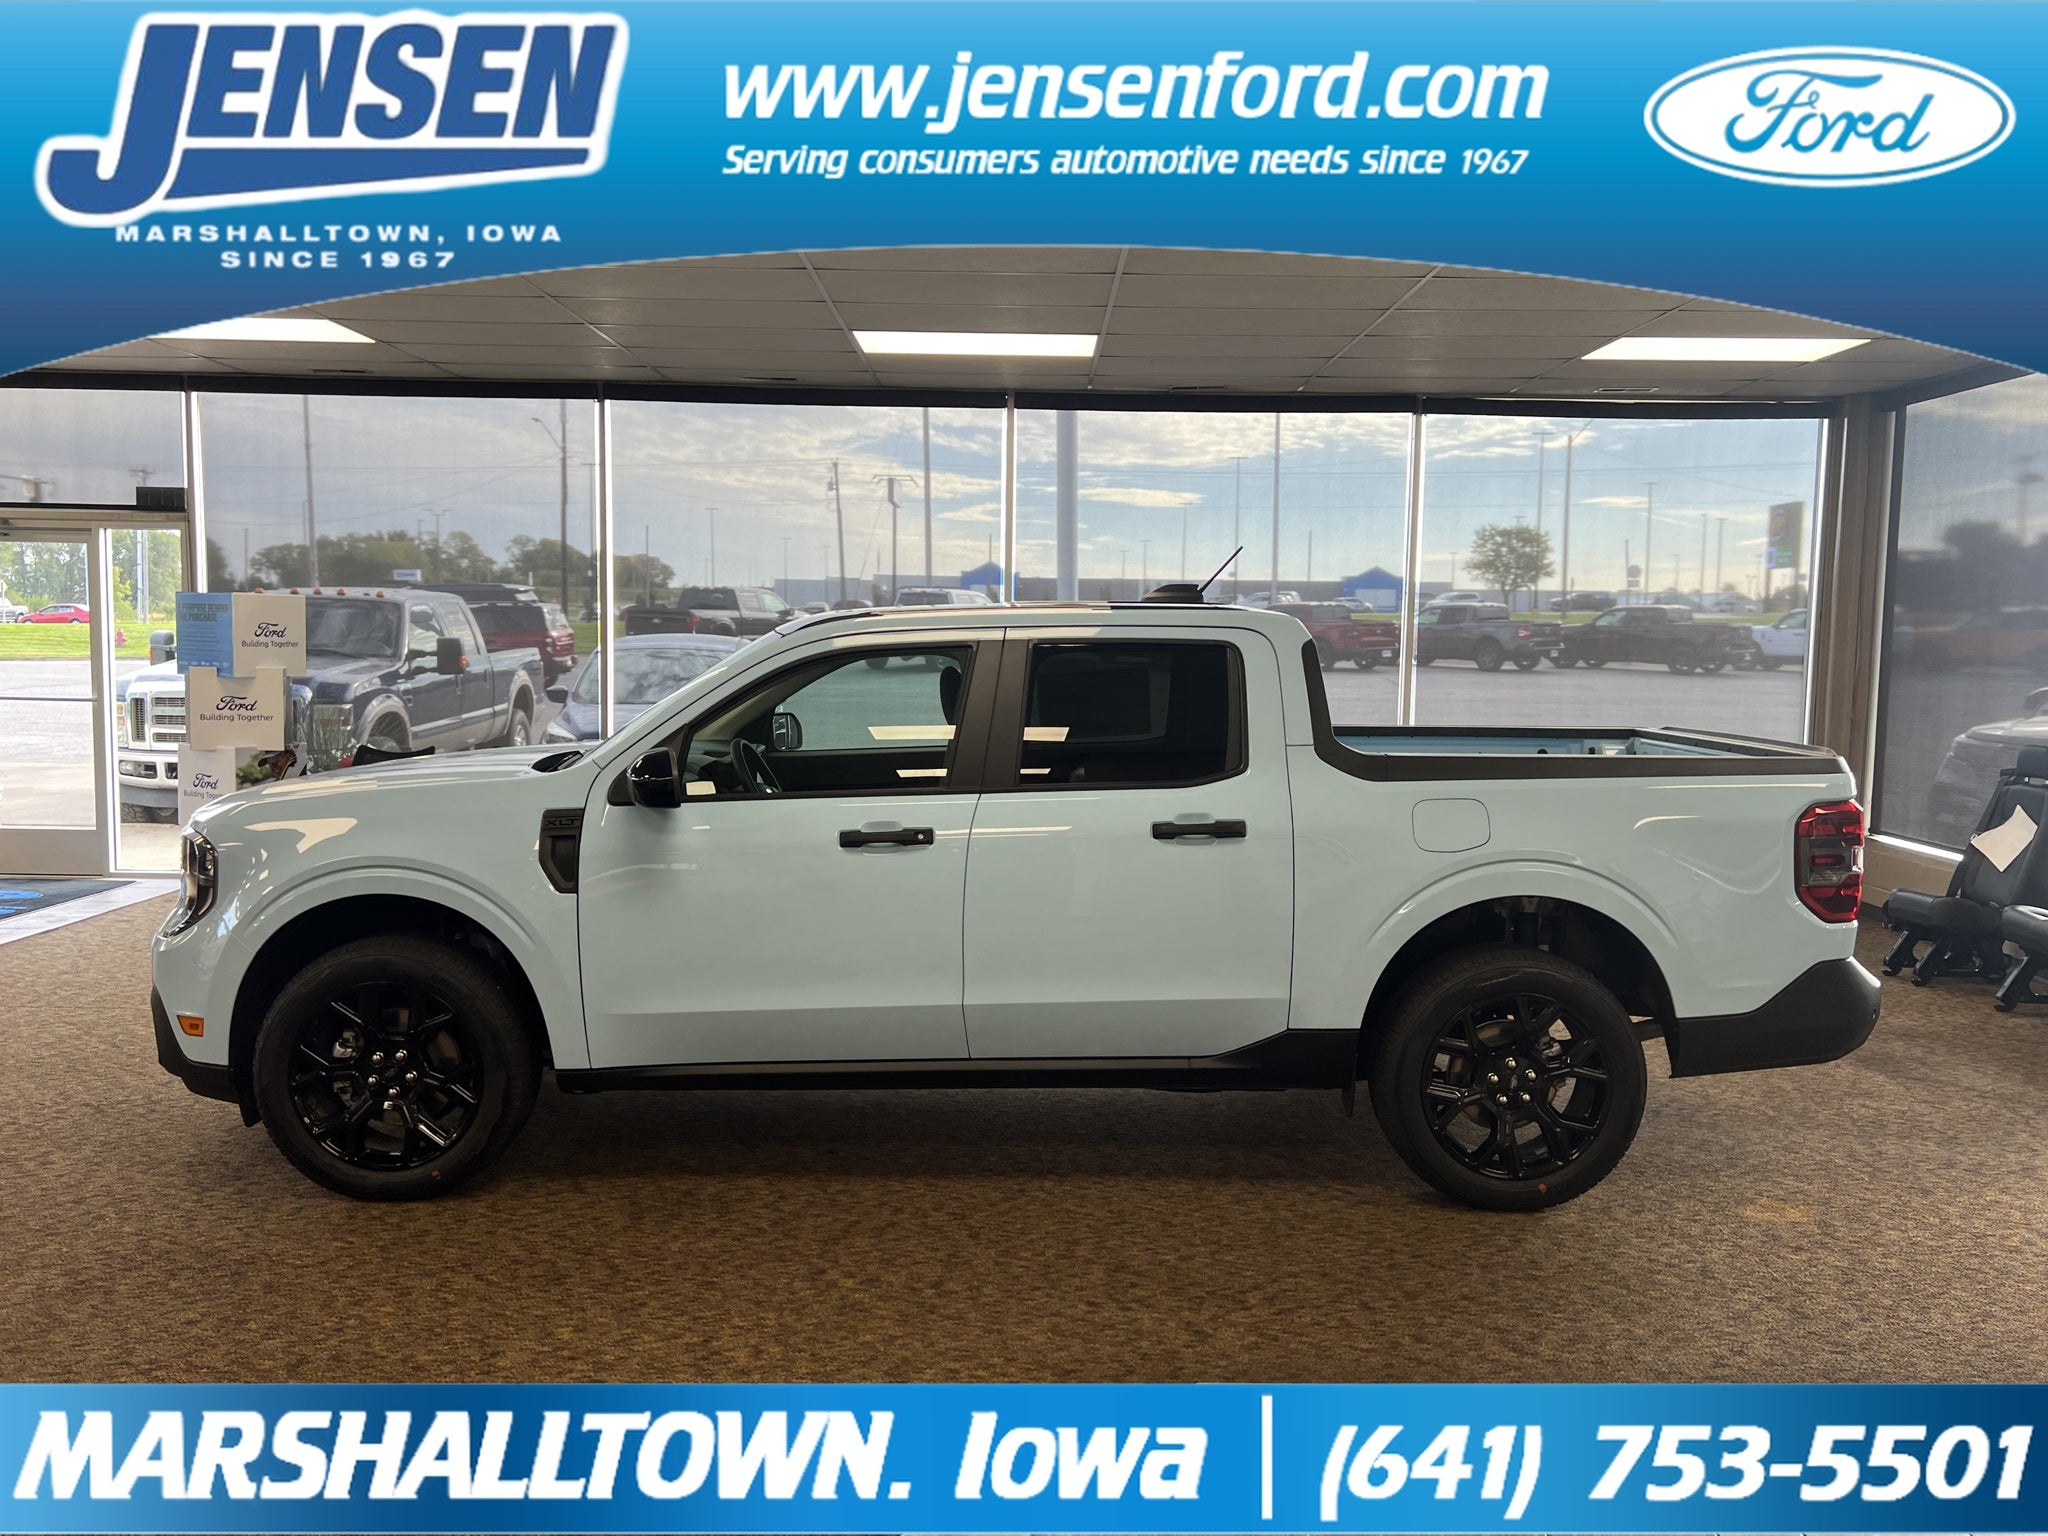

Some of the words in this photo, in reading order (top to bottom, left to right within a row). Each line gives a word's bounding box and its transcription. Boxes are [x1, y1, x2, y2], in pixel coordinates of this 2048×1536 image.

[254, 622, 287, 638] Ford
[241, 640, 269, 649] Building
[271, 640, 299, 649] Together
[216, 695, 258, 711] Ford
[200, 714, 235, 722] Building
[237, 714, 274, 722] Together
[193, 773, 219, 790] Ford
[183, 789, 205, 799] Building
[544, 818, 580, 828] XLT
